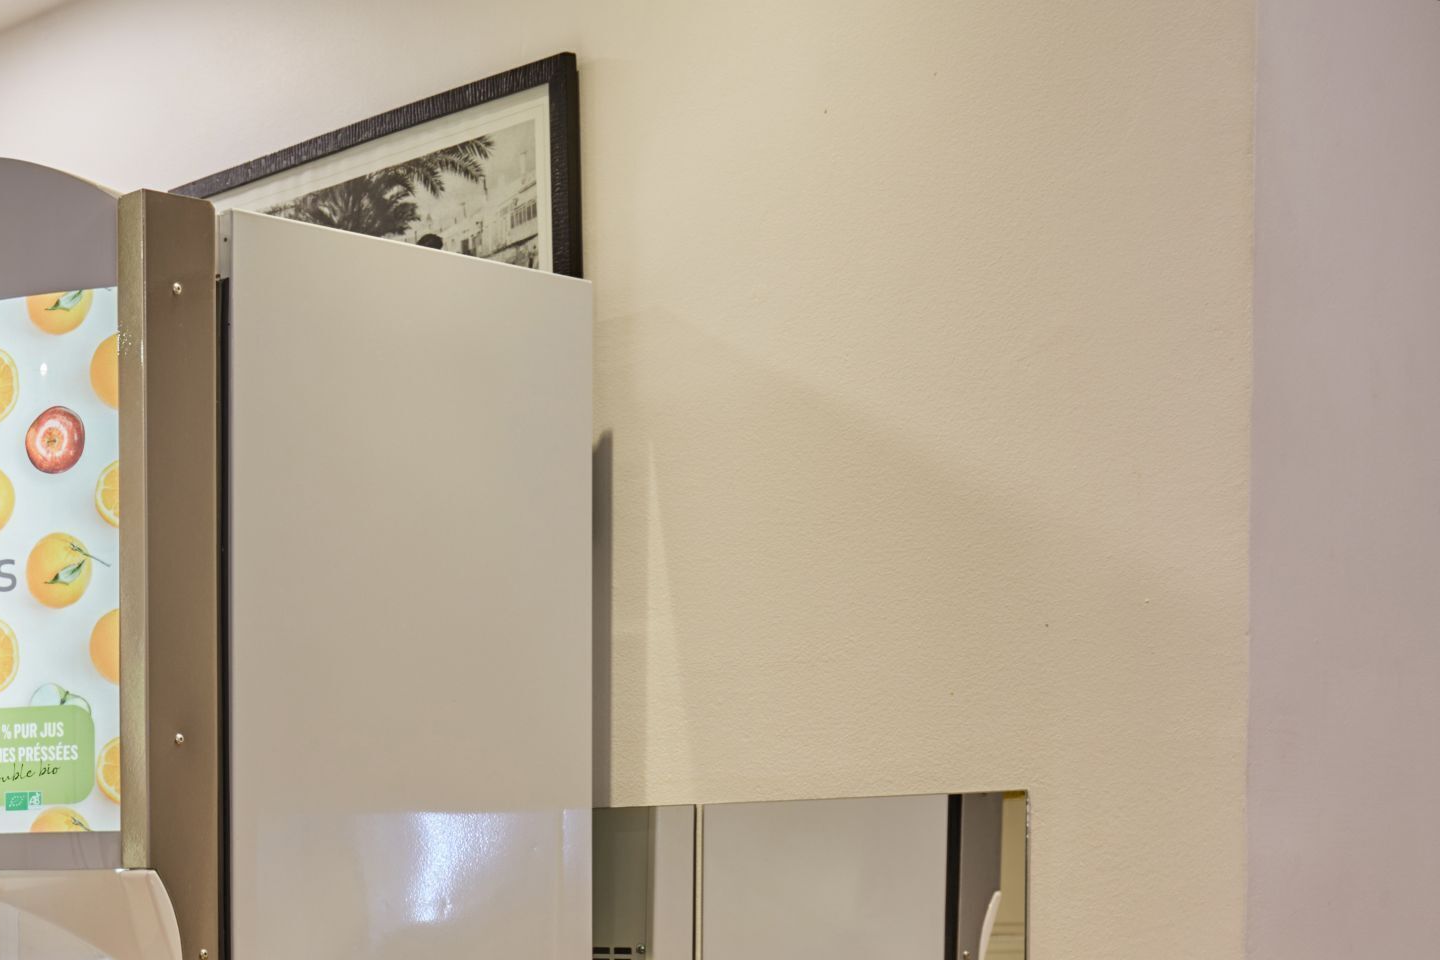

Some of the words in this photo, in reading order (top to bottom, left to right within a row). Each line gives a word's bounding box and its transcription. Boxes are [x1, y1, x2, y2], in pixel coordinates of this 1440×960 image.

[2, 724, 12, 739] %
[14, 723, 37, 739] PUR
[40, 721, 64, 738] JUS
[18, 742, 79, 761] PRÉSSÉES
[39, 759, 61, 777] bio
